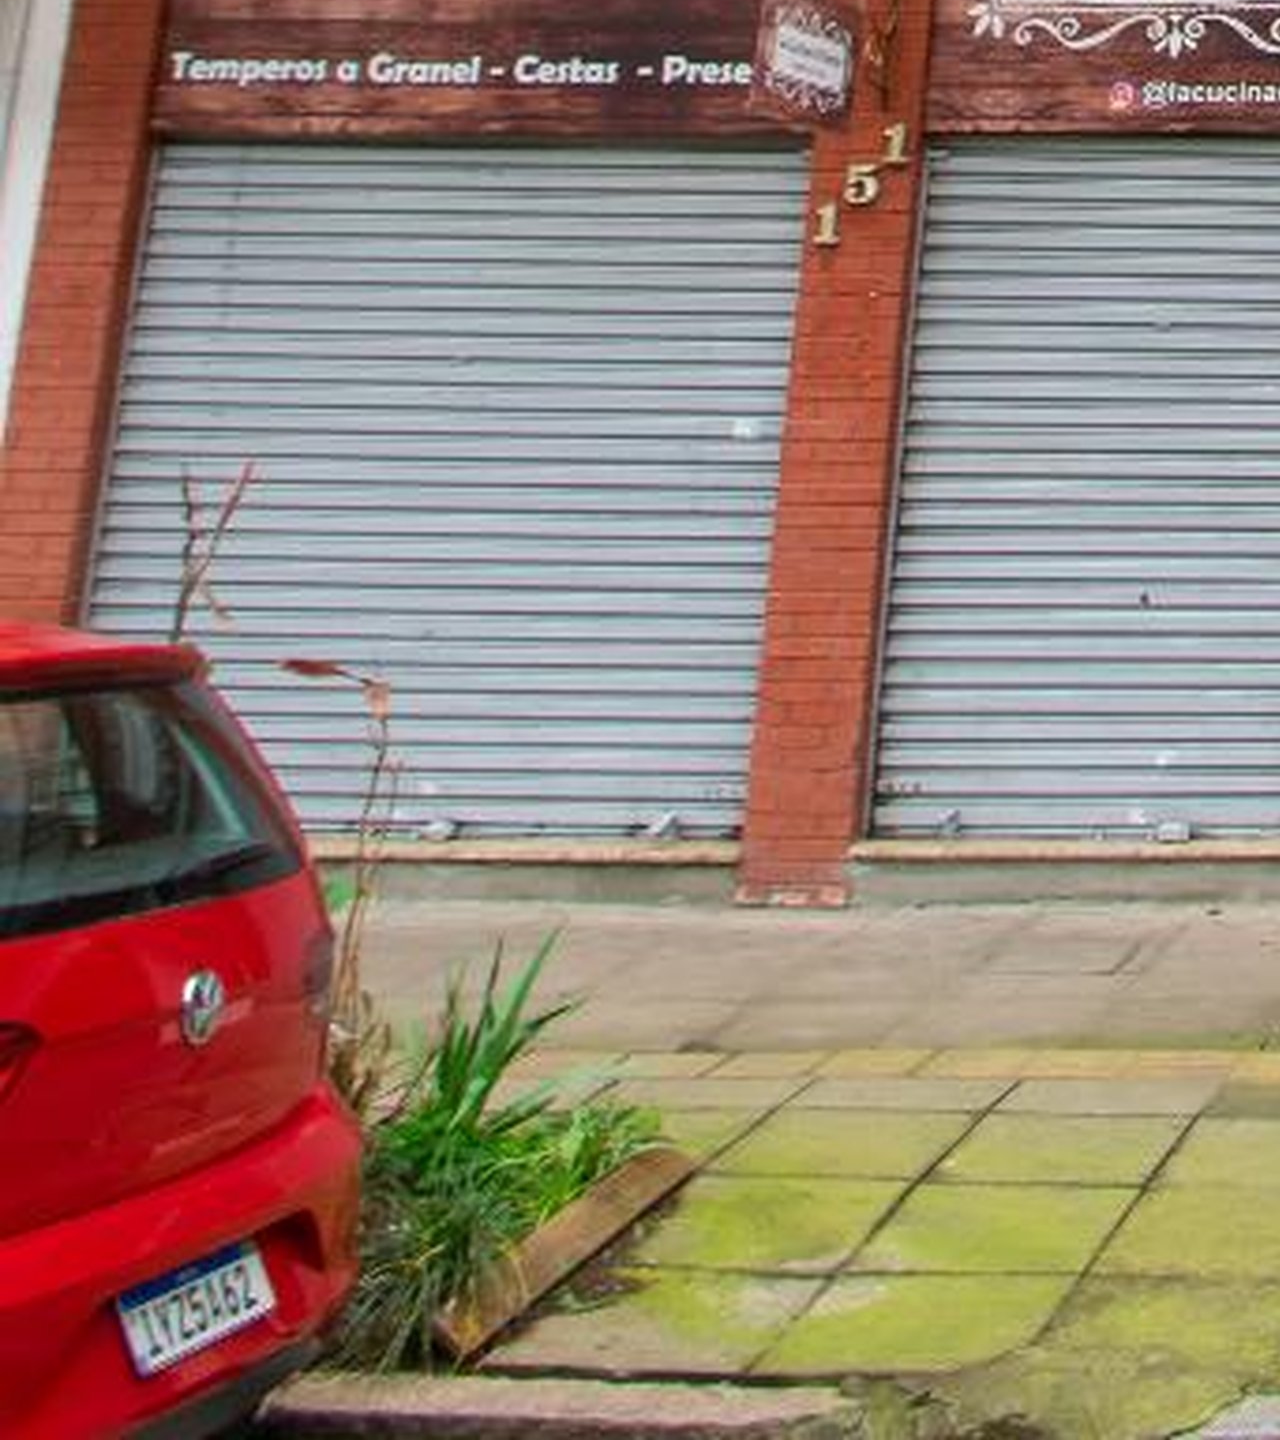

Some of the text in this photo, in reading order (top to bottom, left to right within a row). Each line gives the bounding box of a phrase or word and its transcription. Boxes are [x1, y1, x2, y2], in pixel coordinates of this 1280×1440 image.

[171, 51, 327, 87] Temperos
[336, 58, 359, 82] a
[367, 53, 482, 84] Granel
[513, 55, 620, 84] Cestas
[661, 55, 754, 84] Prese
